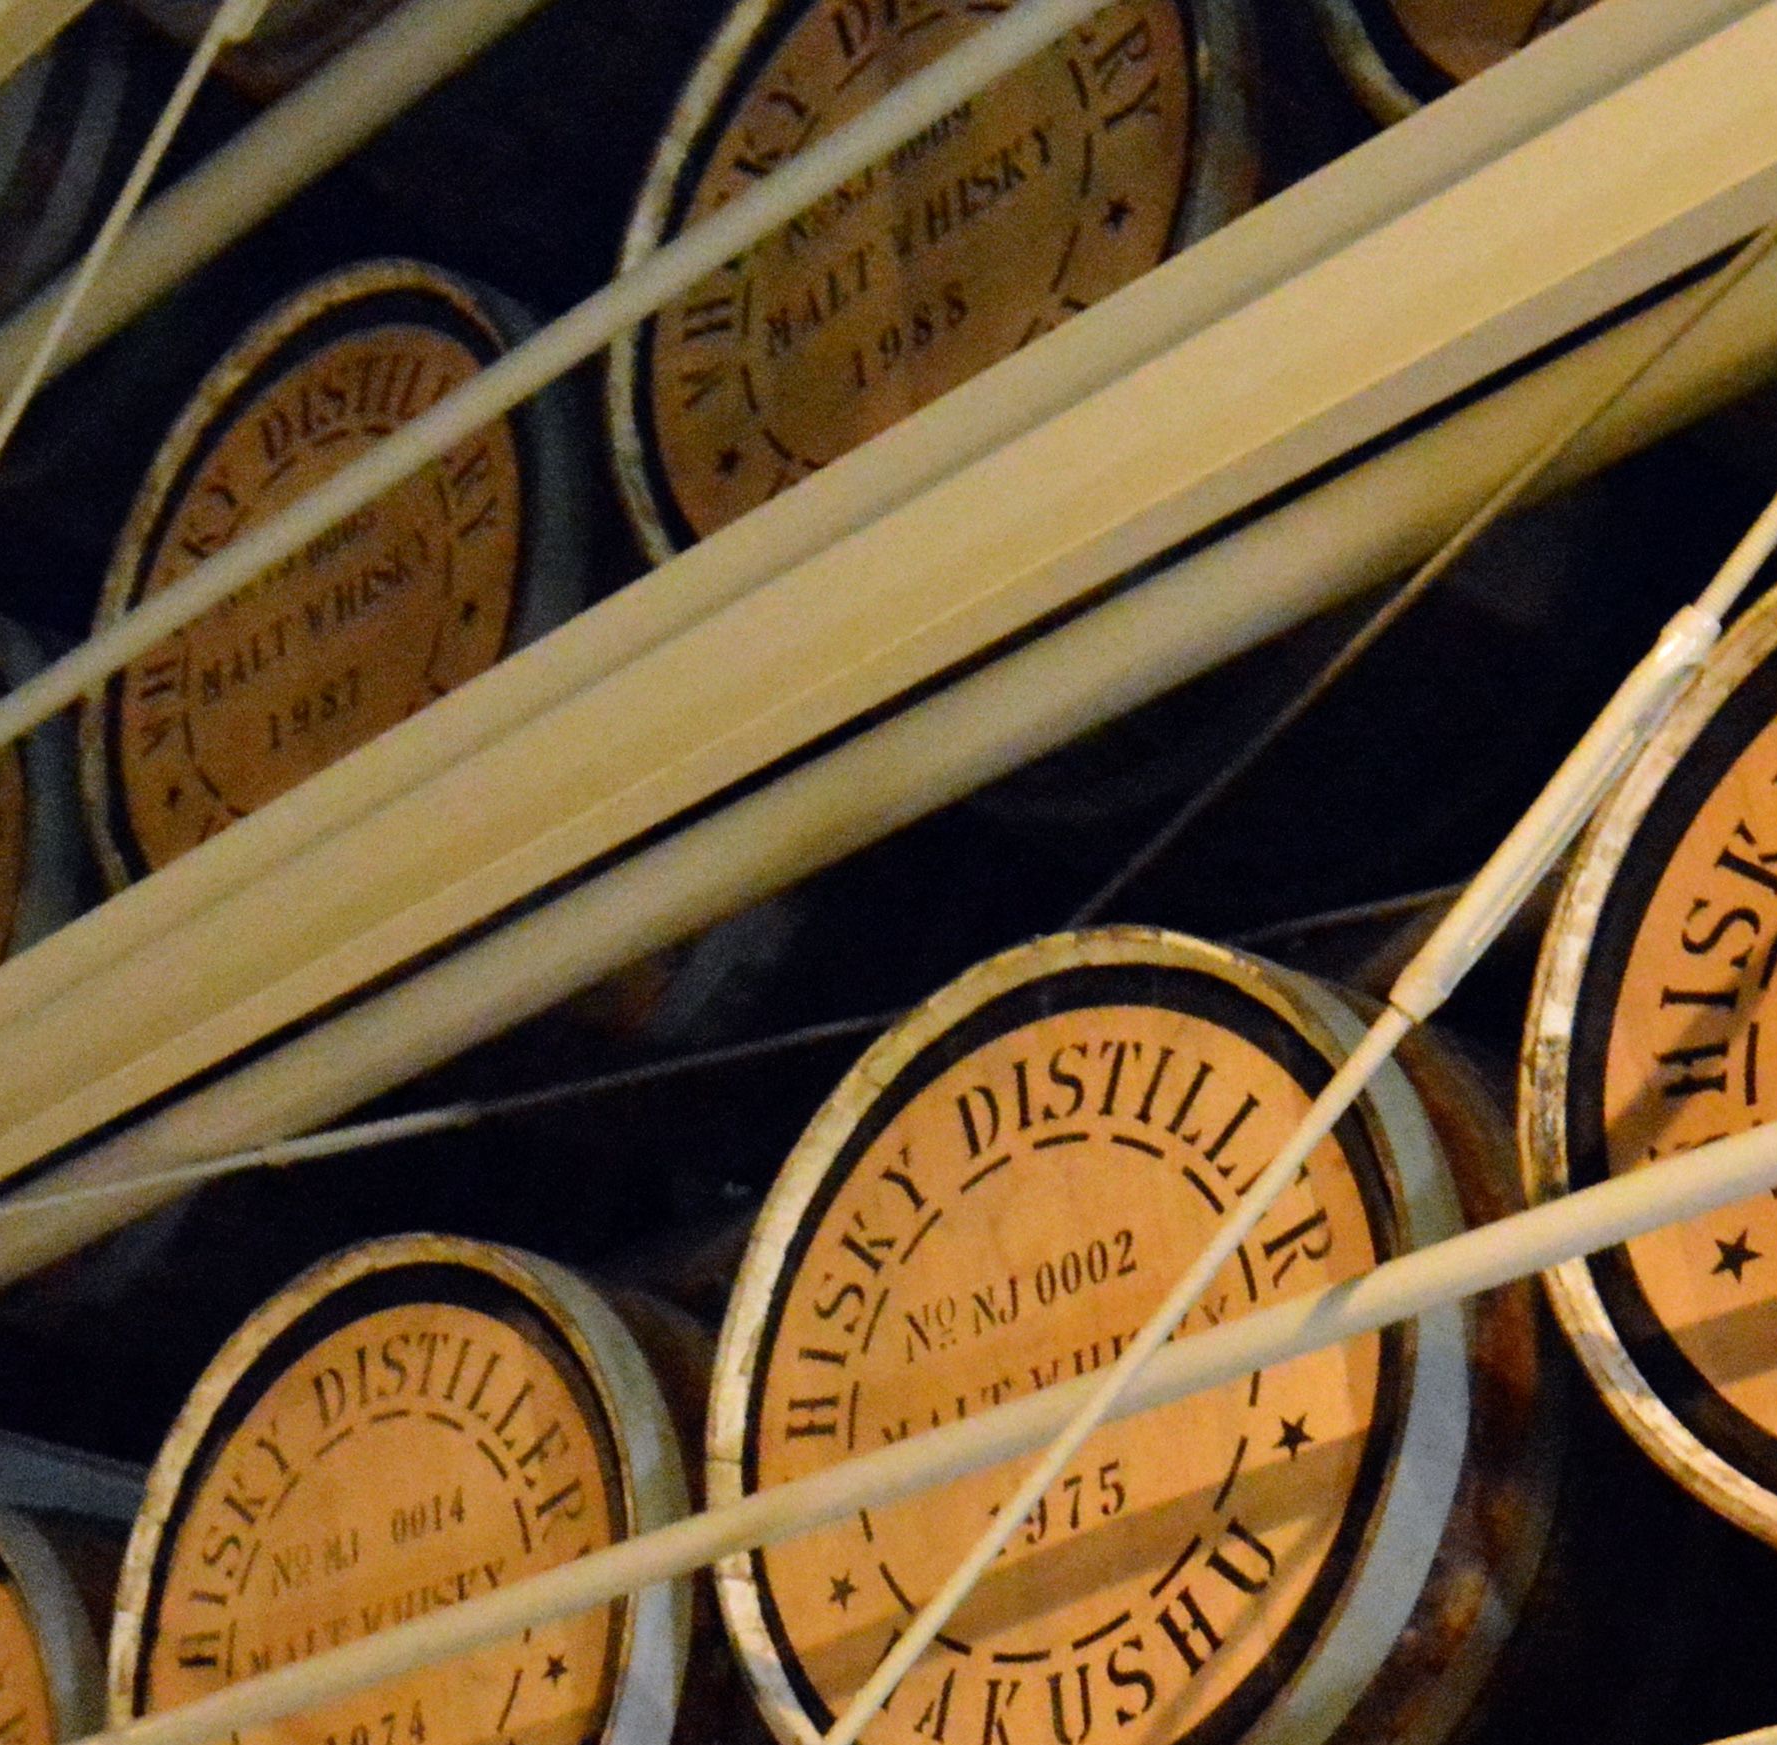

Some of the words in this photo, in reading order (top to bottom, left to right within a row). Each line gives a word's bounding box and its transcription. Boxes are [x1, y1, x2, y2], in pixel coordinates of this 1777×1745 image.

[766, 241, 873, 358] MALT
[892, 124, 1052, 258] WHISKY
[785, 1142, 927, 1442] HISKY
[971, 1274, 1020, 1337] NJ
[1034, 1228, 1138, 1307] 0002
[312, 1331, 590, 1549] DISTILLER
